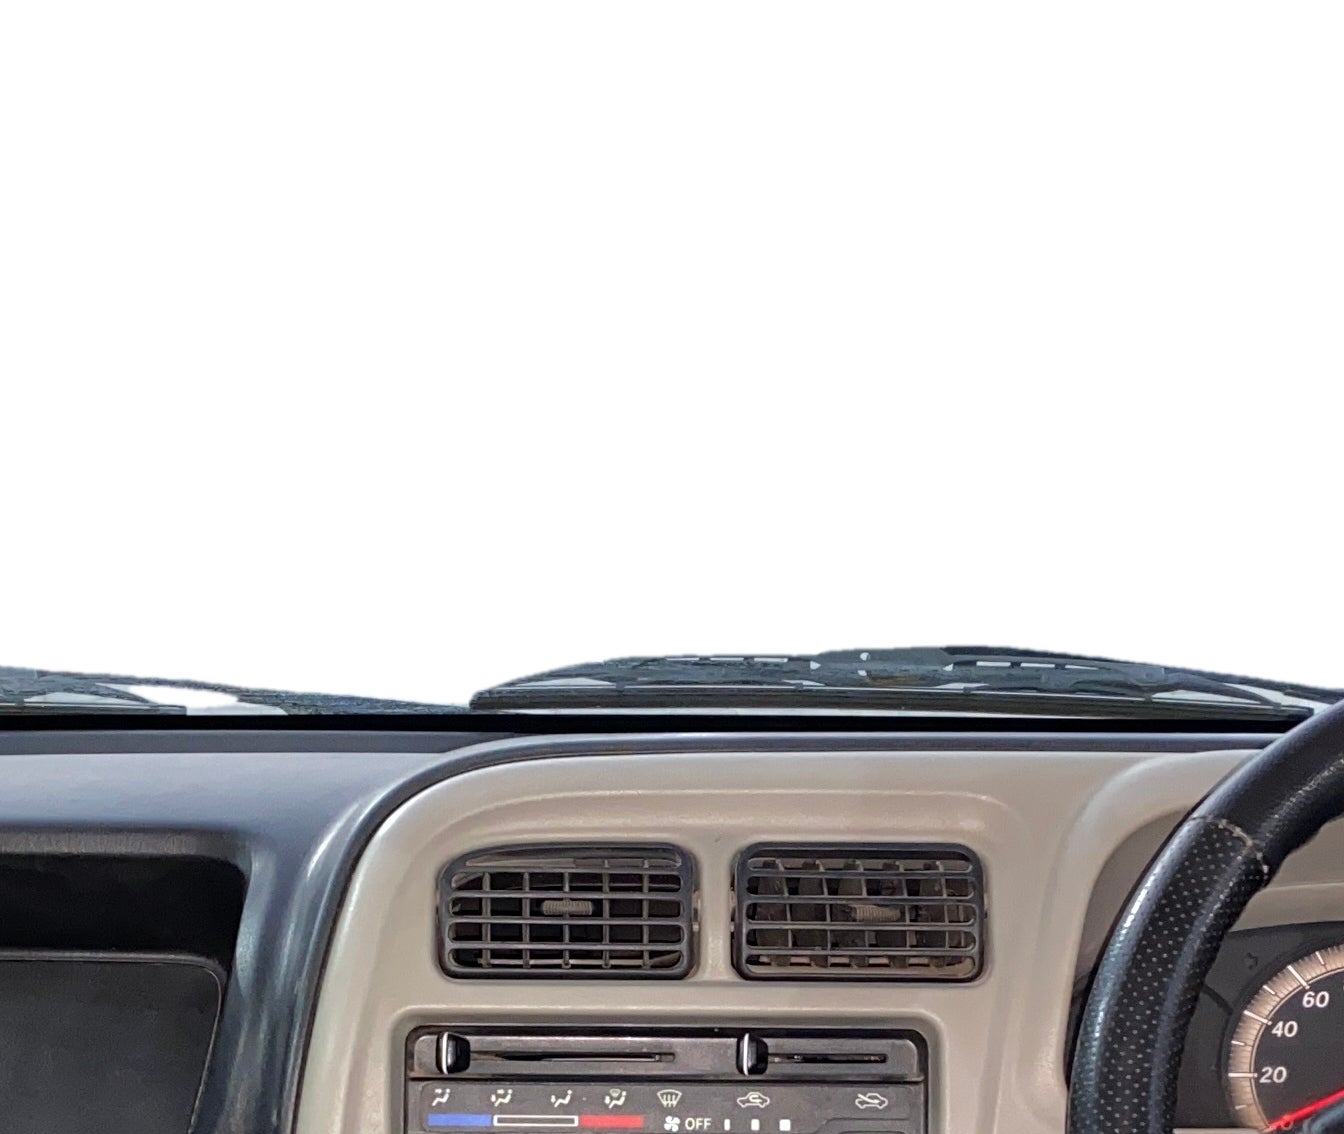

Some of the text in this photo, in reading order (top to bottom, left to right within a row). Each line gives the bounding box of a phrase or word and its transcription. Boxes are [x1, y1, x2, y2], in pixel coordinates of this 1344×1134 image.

[1302, 990, 1330, 1009] 60
[1271, 1020, 1299, 1038] 40
[1259, 1066, 1287, 1084] 20
[684, 1117, 713, 1132] OFF
